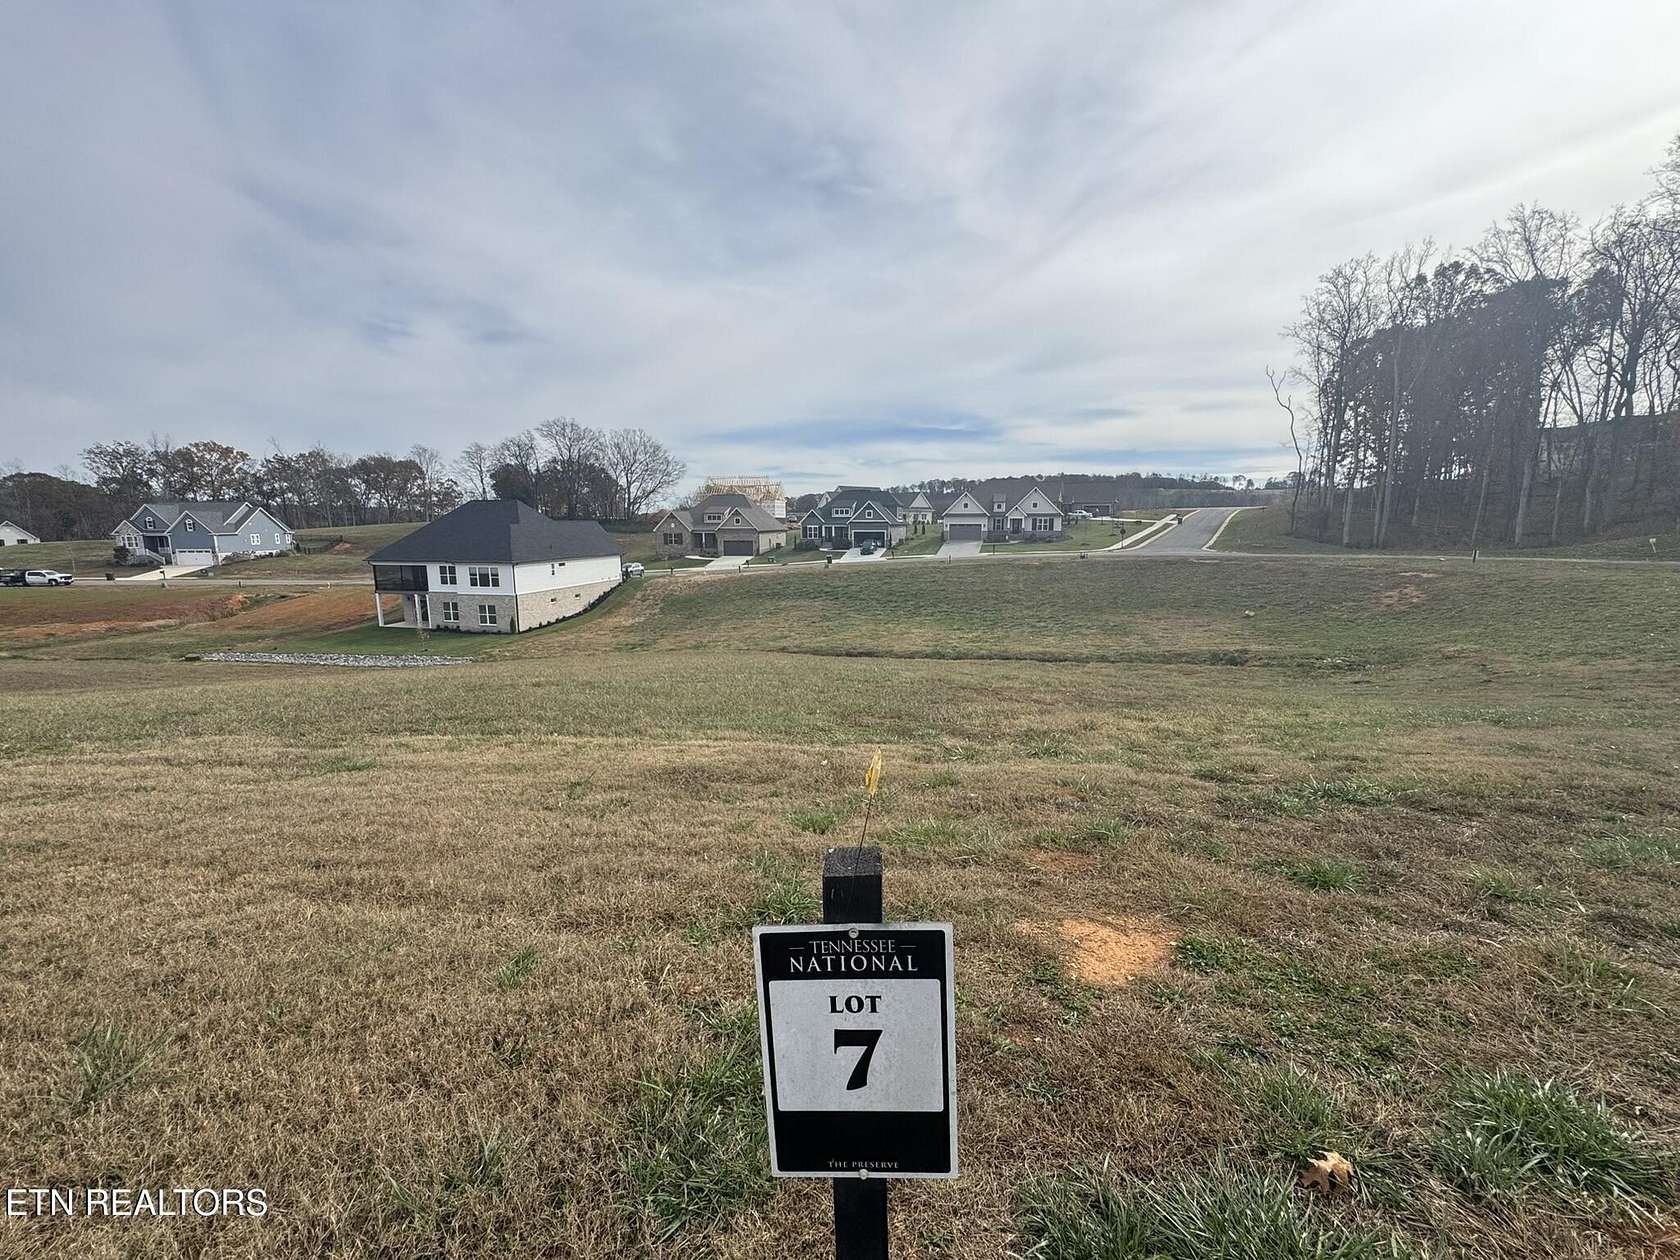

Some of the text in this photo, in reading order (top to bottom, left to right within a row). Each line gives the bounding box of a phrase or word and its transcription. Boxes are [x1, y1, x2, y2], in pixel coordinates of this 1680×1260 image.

[808, 939, 896, 954] TENNESSEE
[790, 954, 918, 972] NATIONAL
[829, 995, 882, 1014] LOT
[833, 1028, 883, 1091] 7
[827, 1159, 899, 1169] THE PRESERVE
